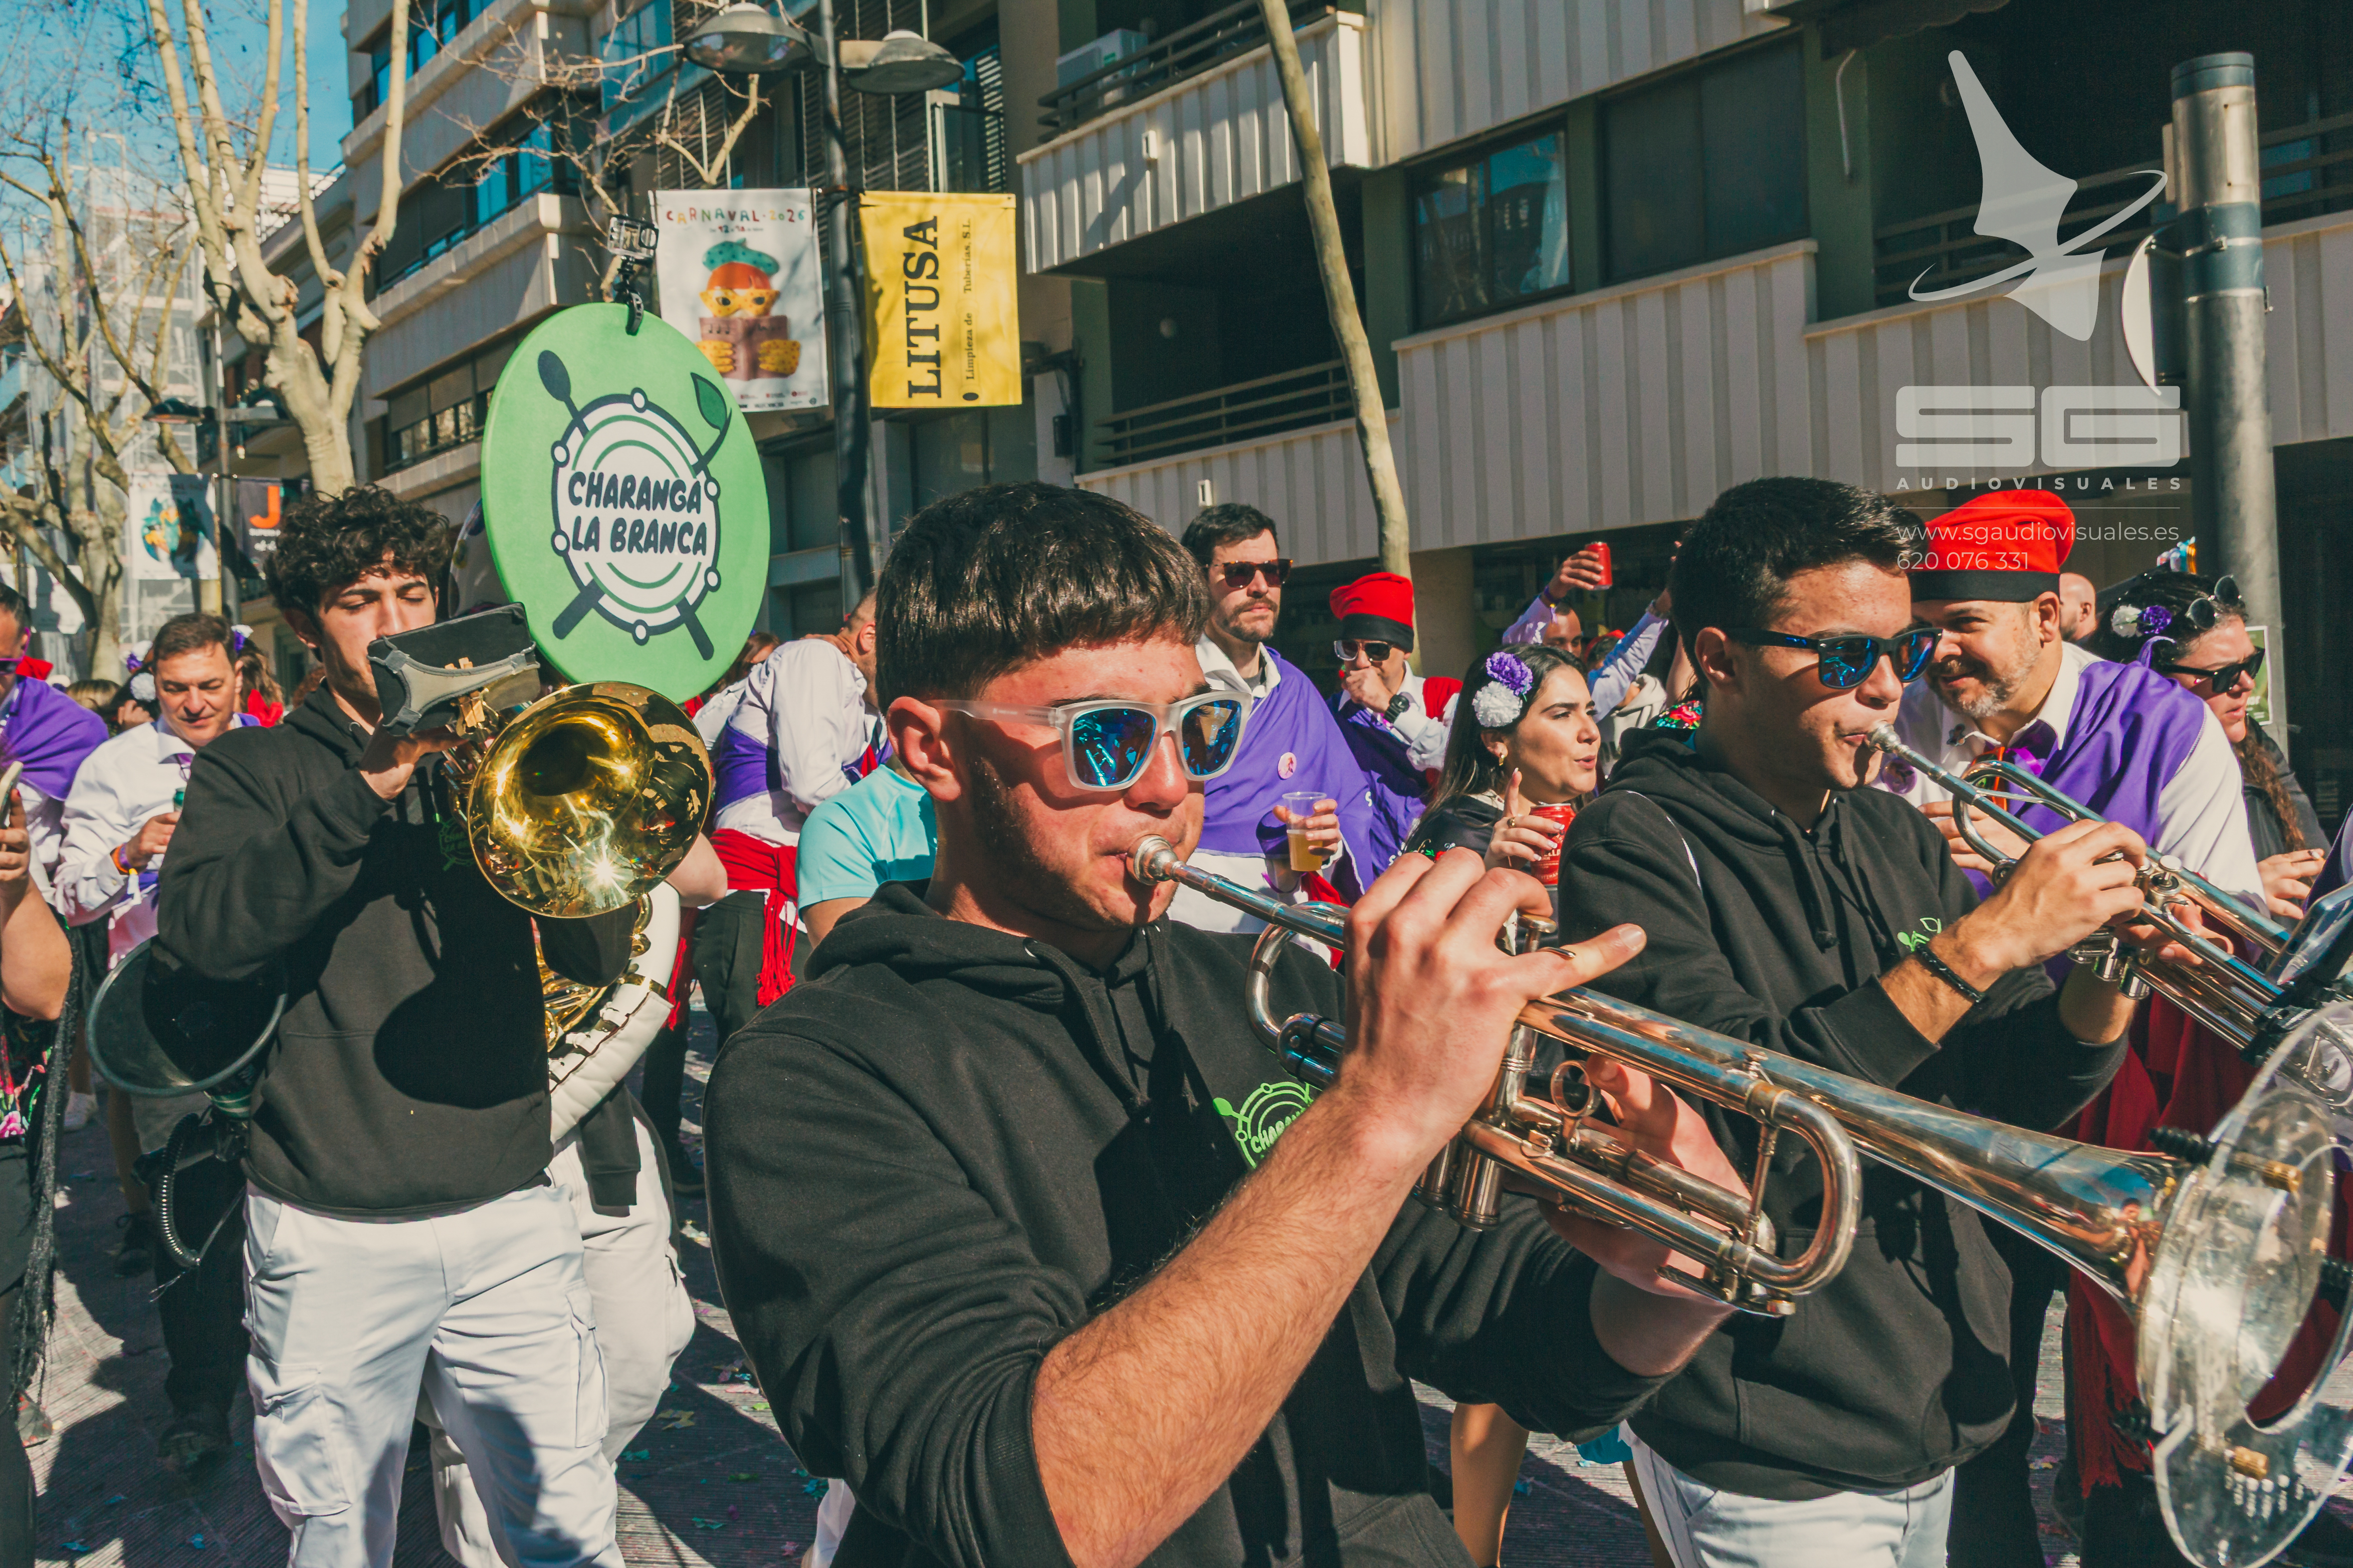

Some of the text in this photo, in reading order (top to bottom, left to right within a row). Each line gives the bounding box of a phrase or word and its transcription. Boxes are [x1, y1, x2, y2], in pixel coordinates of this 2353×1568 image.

[667, 207, 805, 223] CARNAVAL 2026
[903, 216, 941, 398] LITUSA
[964, 312, 973, 326] de
[966, 329, 976, 380] Limpieza
[568, 472, 701, 514] CHARANGA
[572, 516, 707, 556] LA BRANCA
